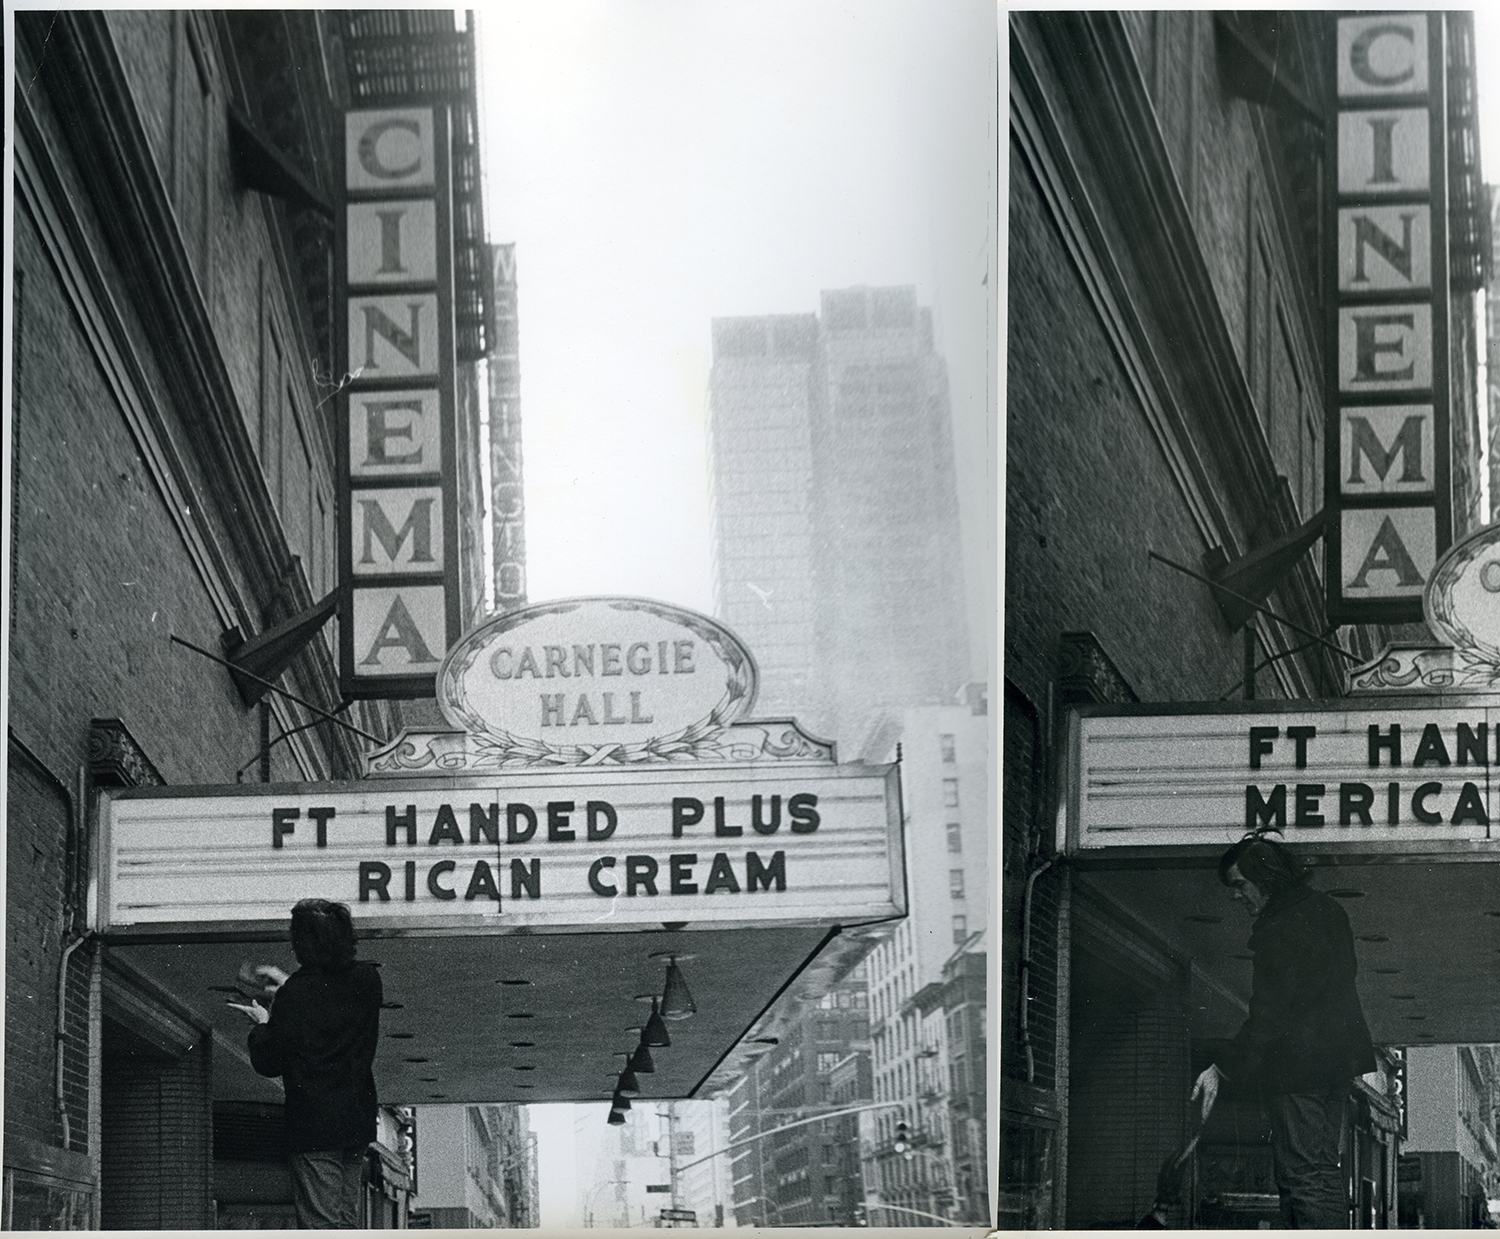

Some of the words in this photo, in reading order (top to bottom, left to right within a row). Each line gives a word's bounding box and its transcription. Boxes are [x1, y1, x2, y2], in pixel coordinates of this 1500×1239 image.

[1345, 25, 1427, 589] CINEMA
[357, 117, 440, 666] CINEMA
[490, 640, 696, 681] CARNEGIE
[540, 691, 654, 728] HALL
[1248, 725, 1317, 772] FT
[272, 806, 337, 850] FT
[385, 800, 618, 847] HANDED
[671, 792, 821, 839] PLUS
[358, 858, 542, 904] RICAN
[587, 850, 787, 898] CREAM
